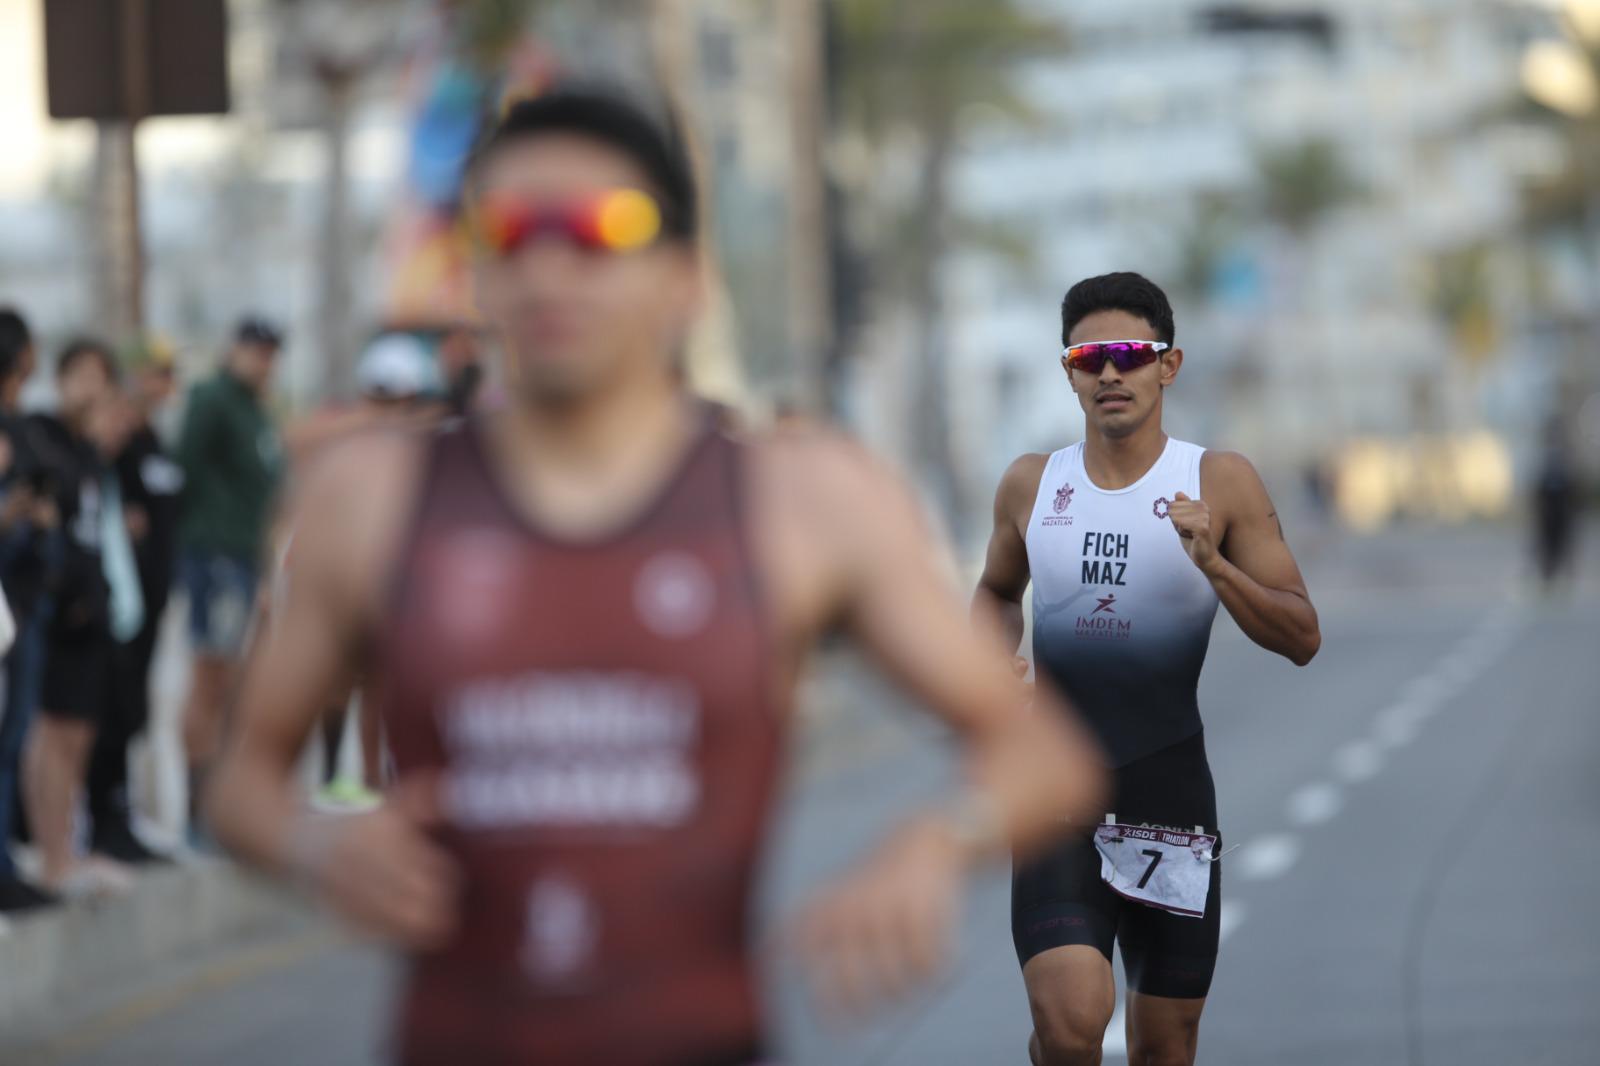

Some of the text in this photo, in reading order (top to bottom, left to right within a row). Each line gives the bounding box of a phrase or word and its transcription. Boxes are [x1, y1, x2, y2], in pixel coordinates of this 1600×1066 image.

[1082, 531, 1129, 558] FICH
[1081, 560, 1127, 586] MAZ
[1075, 616, 1131, 631] IMDEM
[1136, 849, 1163, 889] 7
